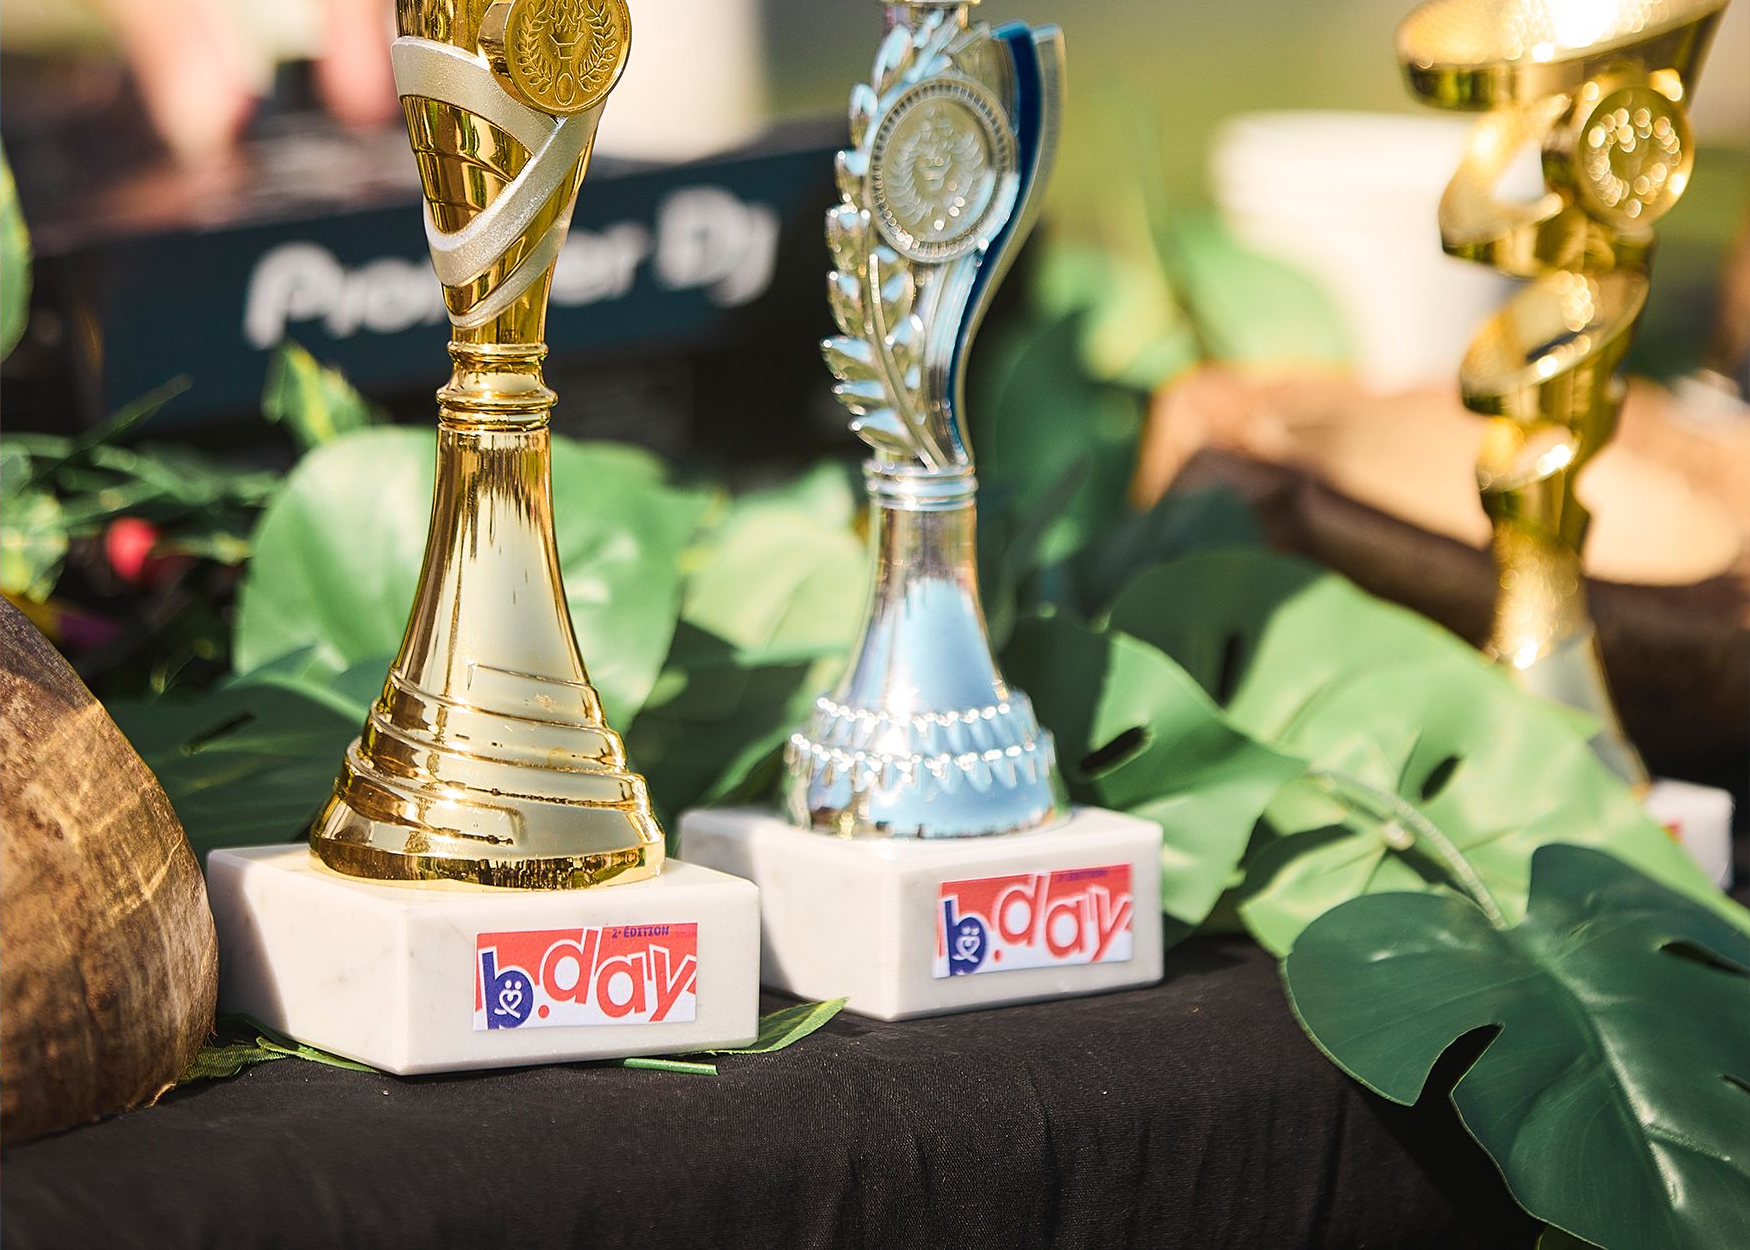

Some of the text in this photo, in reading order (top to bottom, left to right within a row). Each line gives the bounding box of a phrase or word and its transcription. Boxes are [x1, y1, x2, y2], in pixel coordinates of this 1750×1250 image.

[623, 925, 670, 939] ÉDITION
[940, 871, 1134, 977] b.day
[480, 927, 698, 1031] b.day
